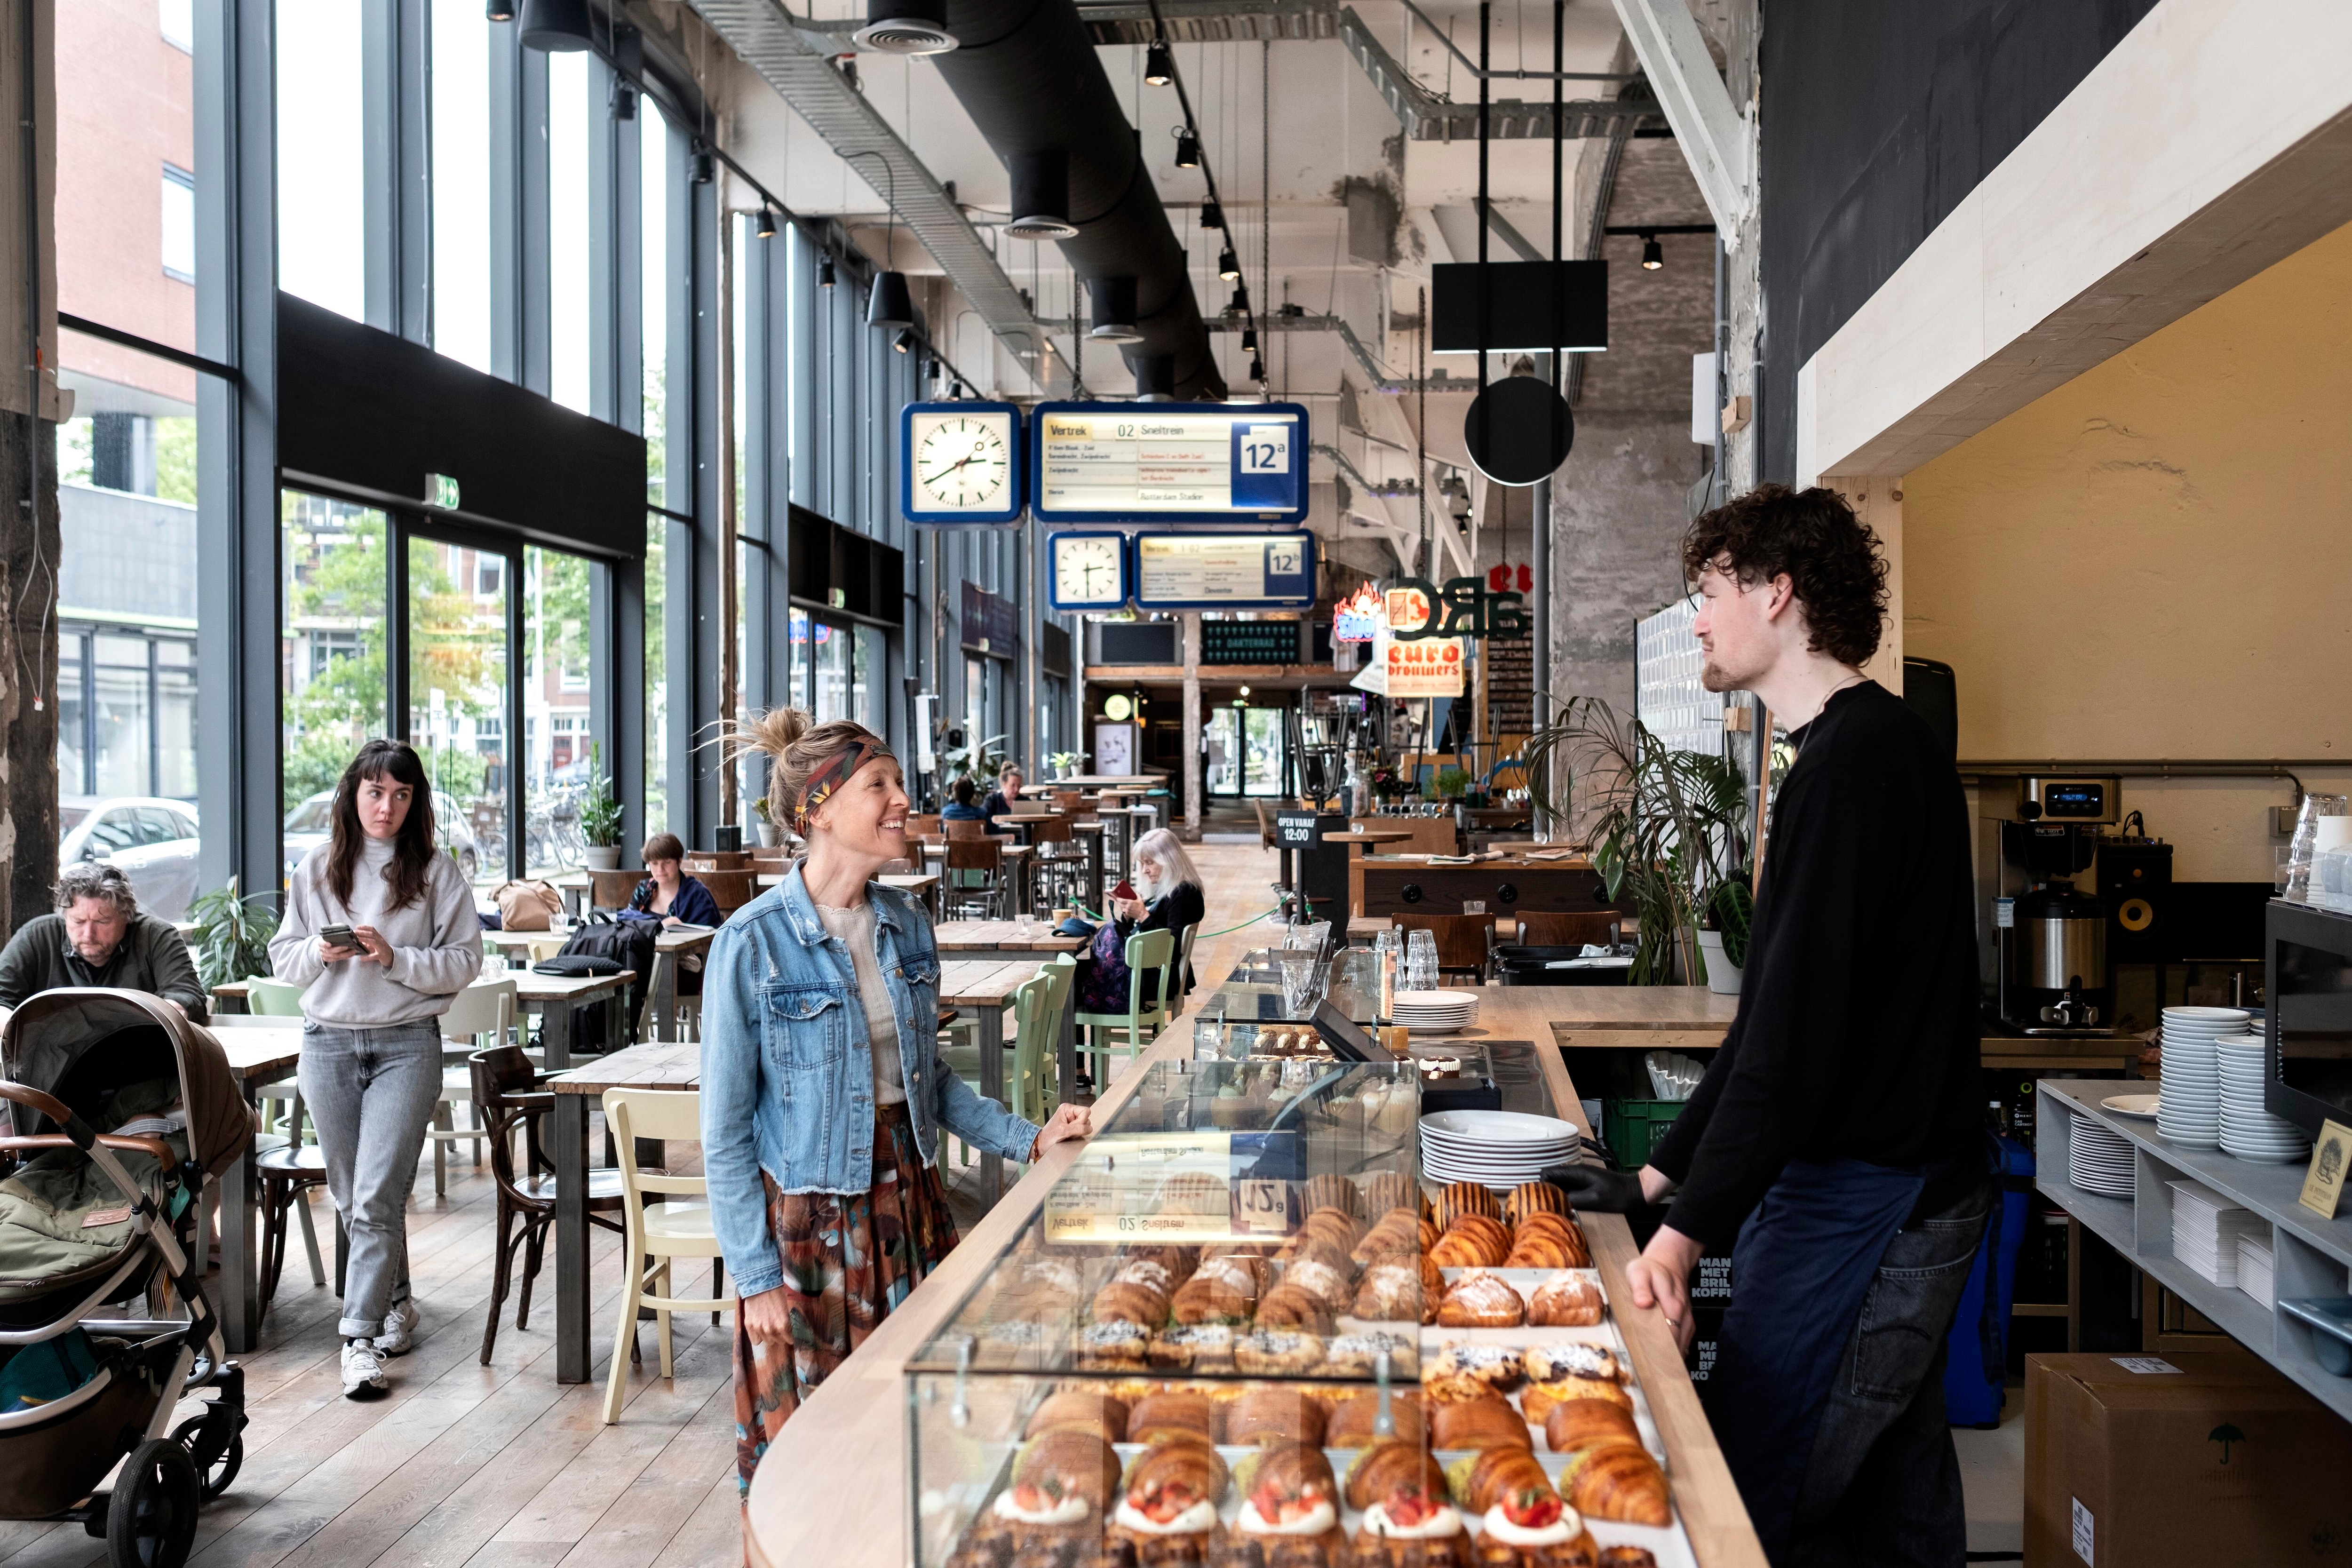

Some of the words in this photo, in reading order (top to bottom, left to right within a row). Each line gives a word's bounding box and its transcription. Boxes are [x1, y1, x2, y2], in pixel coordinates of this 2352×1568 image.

[1050, 425, 1087, 436] Vertrek
[1118, 424, 1134, 437] 02
[1141, 425, 1184, 435] Sneltrein
[1388, 645, 1459, 663] euro
[1388, 664, 1459, 677] brouwers
[1278, 817, 1294, 827] OPEN
[1295, 818, 1315, 828] VANAF
[1284, 828, 1309, 841] 12:00
[1699, 1258, 1731, 1267] MAN
[1701, 1268, 1730, 1277] MET
[1700, 1278, 1730, 1287] BRIL
[1692, 1288, 1733, 1297] KOFFI
[1698, 1341, 1717, 1350] MA
